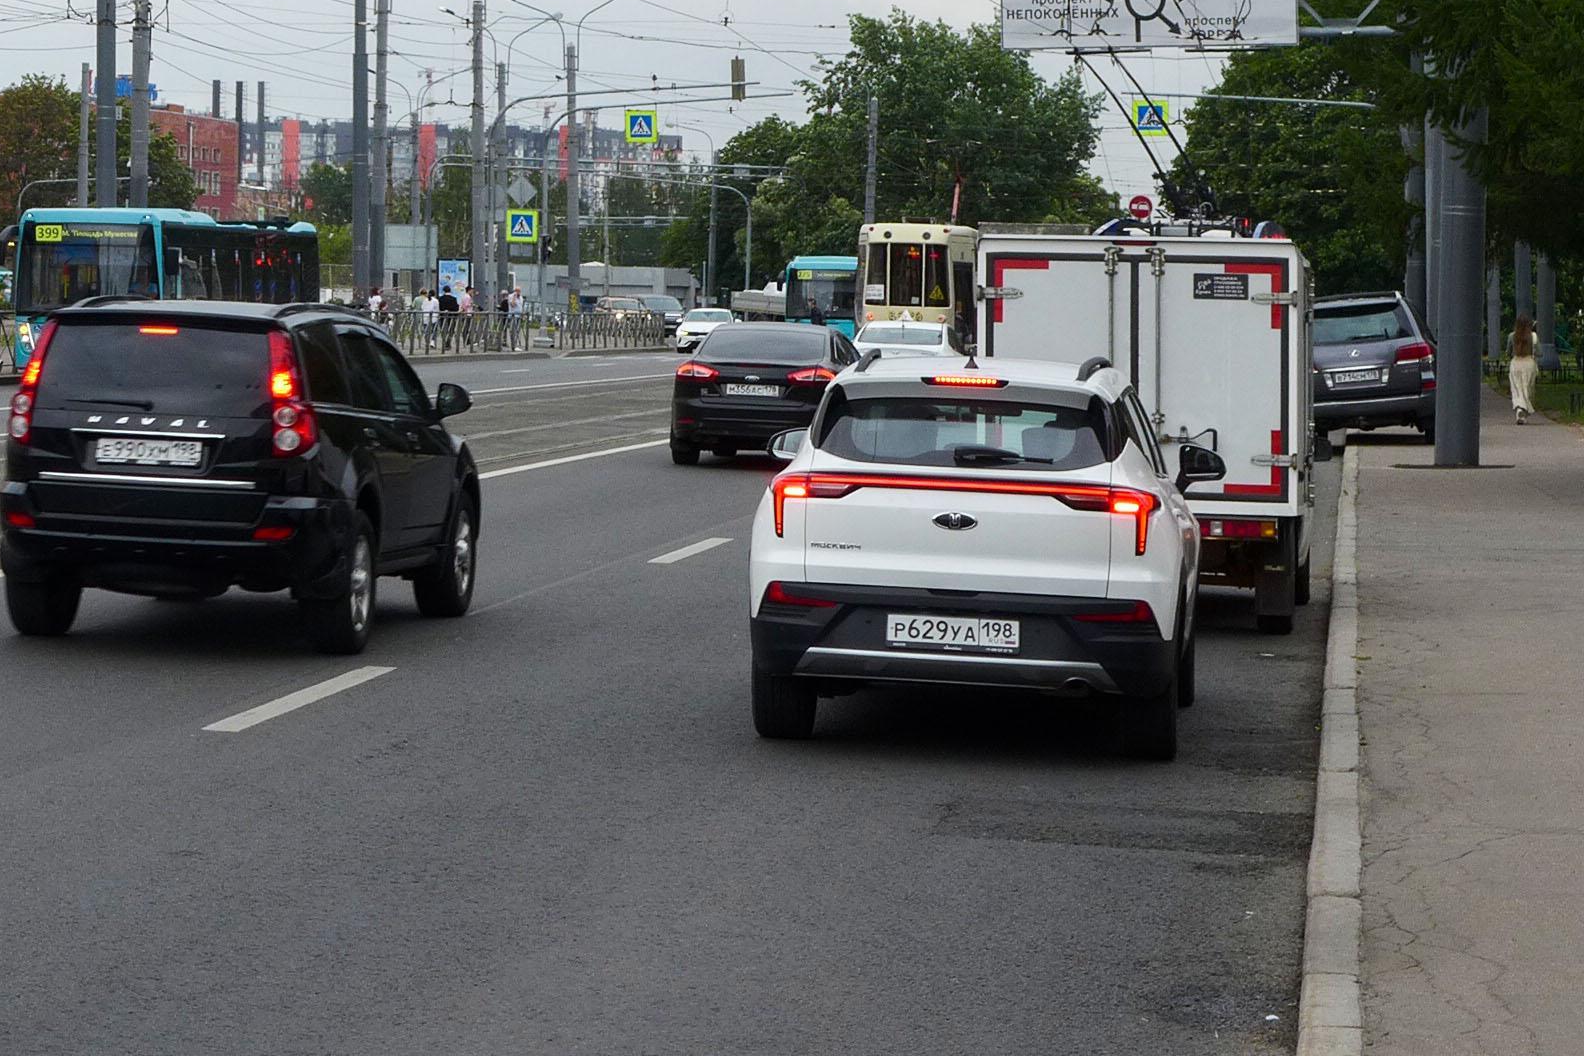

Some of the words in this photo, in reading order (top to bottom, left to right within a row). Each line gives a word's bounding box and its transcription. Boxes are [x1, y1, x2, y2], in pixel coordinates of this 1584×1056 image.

[37, 226, 59, 239] 399
[87, 416, 209, 428] HAVAL
[894, 619, 976, 643] Р629УА
[981, 622, 1013, 639] 198
